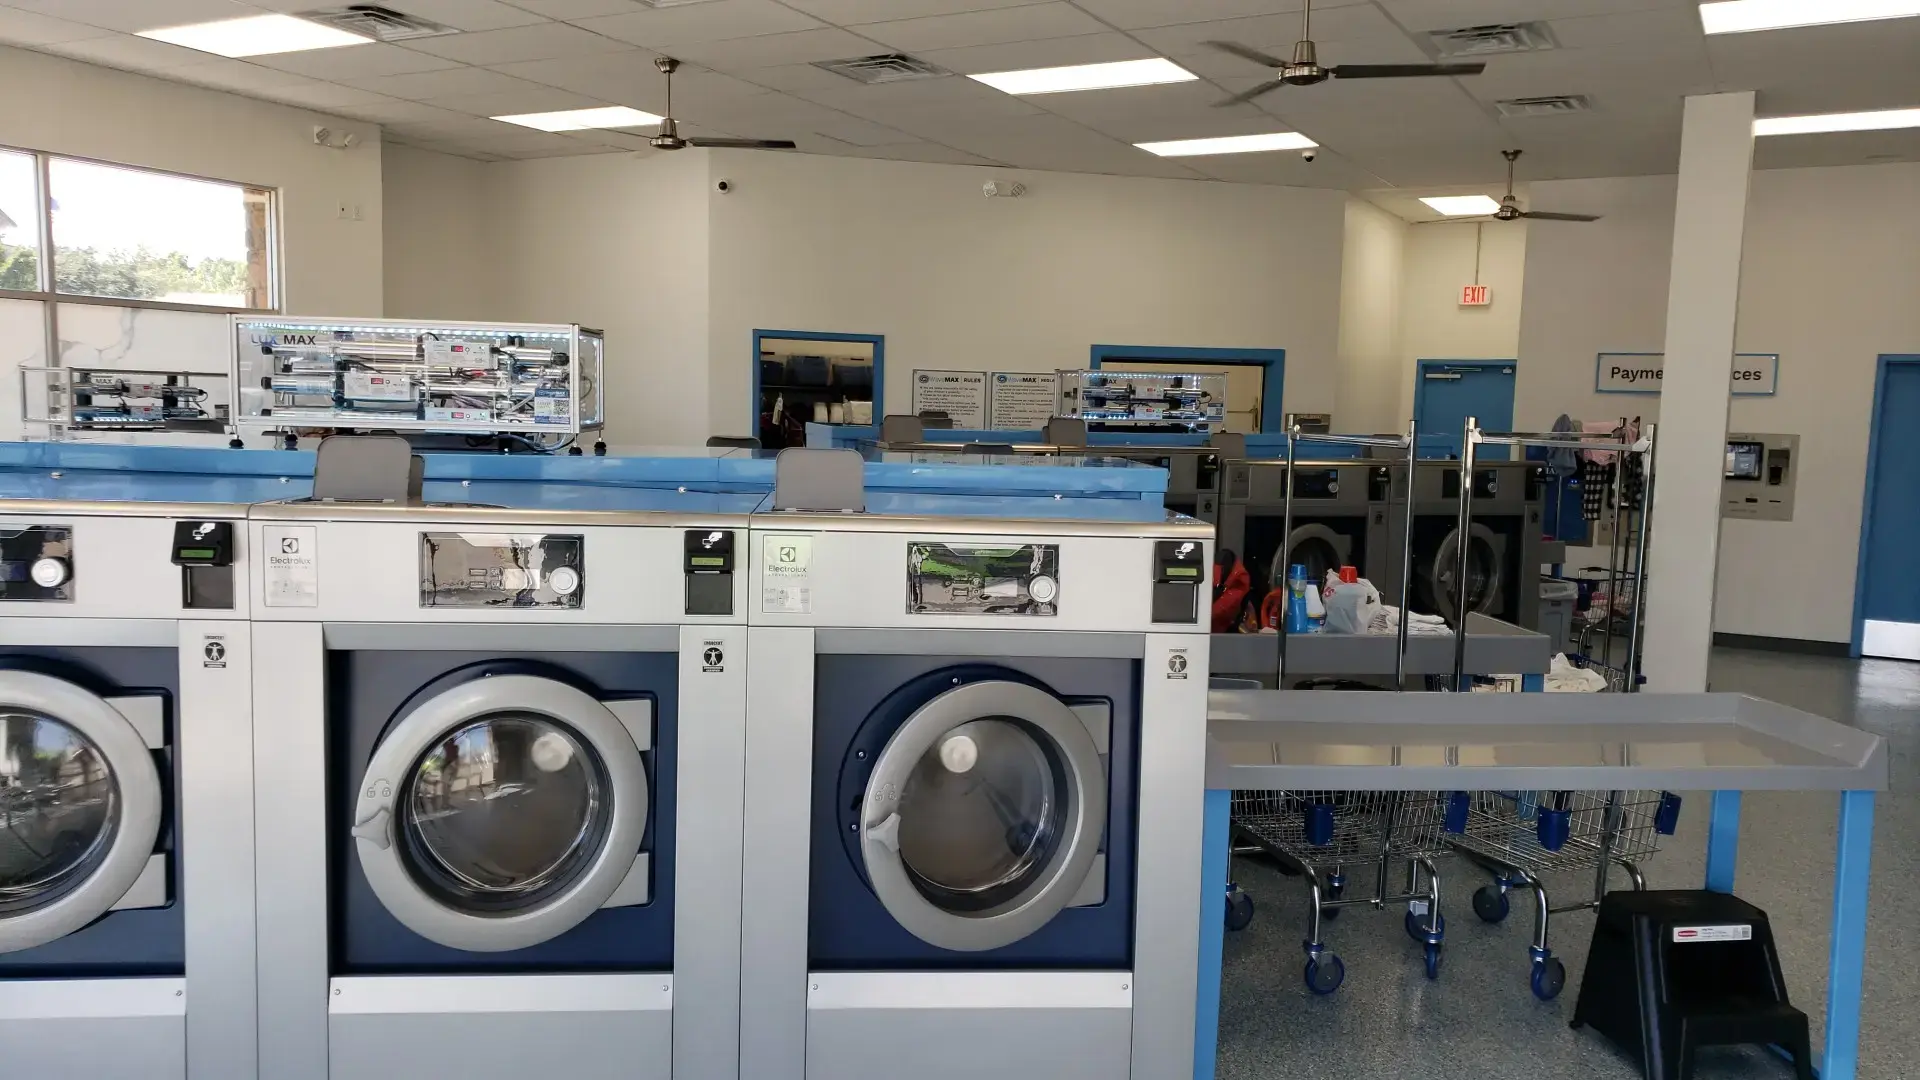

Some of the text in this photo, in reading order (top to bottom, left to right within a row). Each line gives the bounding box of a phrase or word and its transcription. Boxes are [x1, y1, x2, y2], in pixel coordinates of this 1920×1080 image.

[1463, 286, 1487, 303] EXIT
[283, 334, 317, 346] MAX
[1611, 366, 1664, 383] Payme
[270, 556, 311, 565] Electrolux
[768, 564, 807, 573] Electrolux
